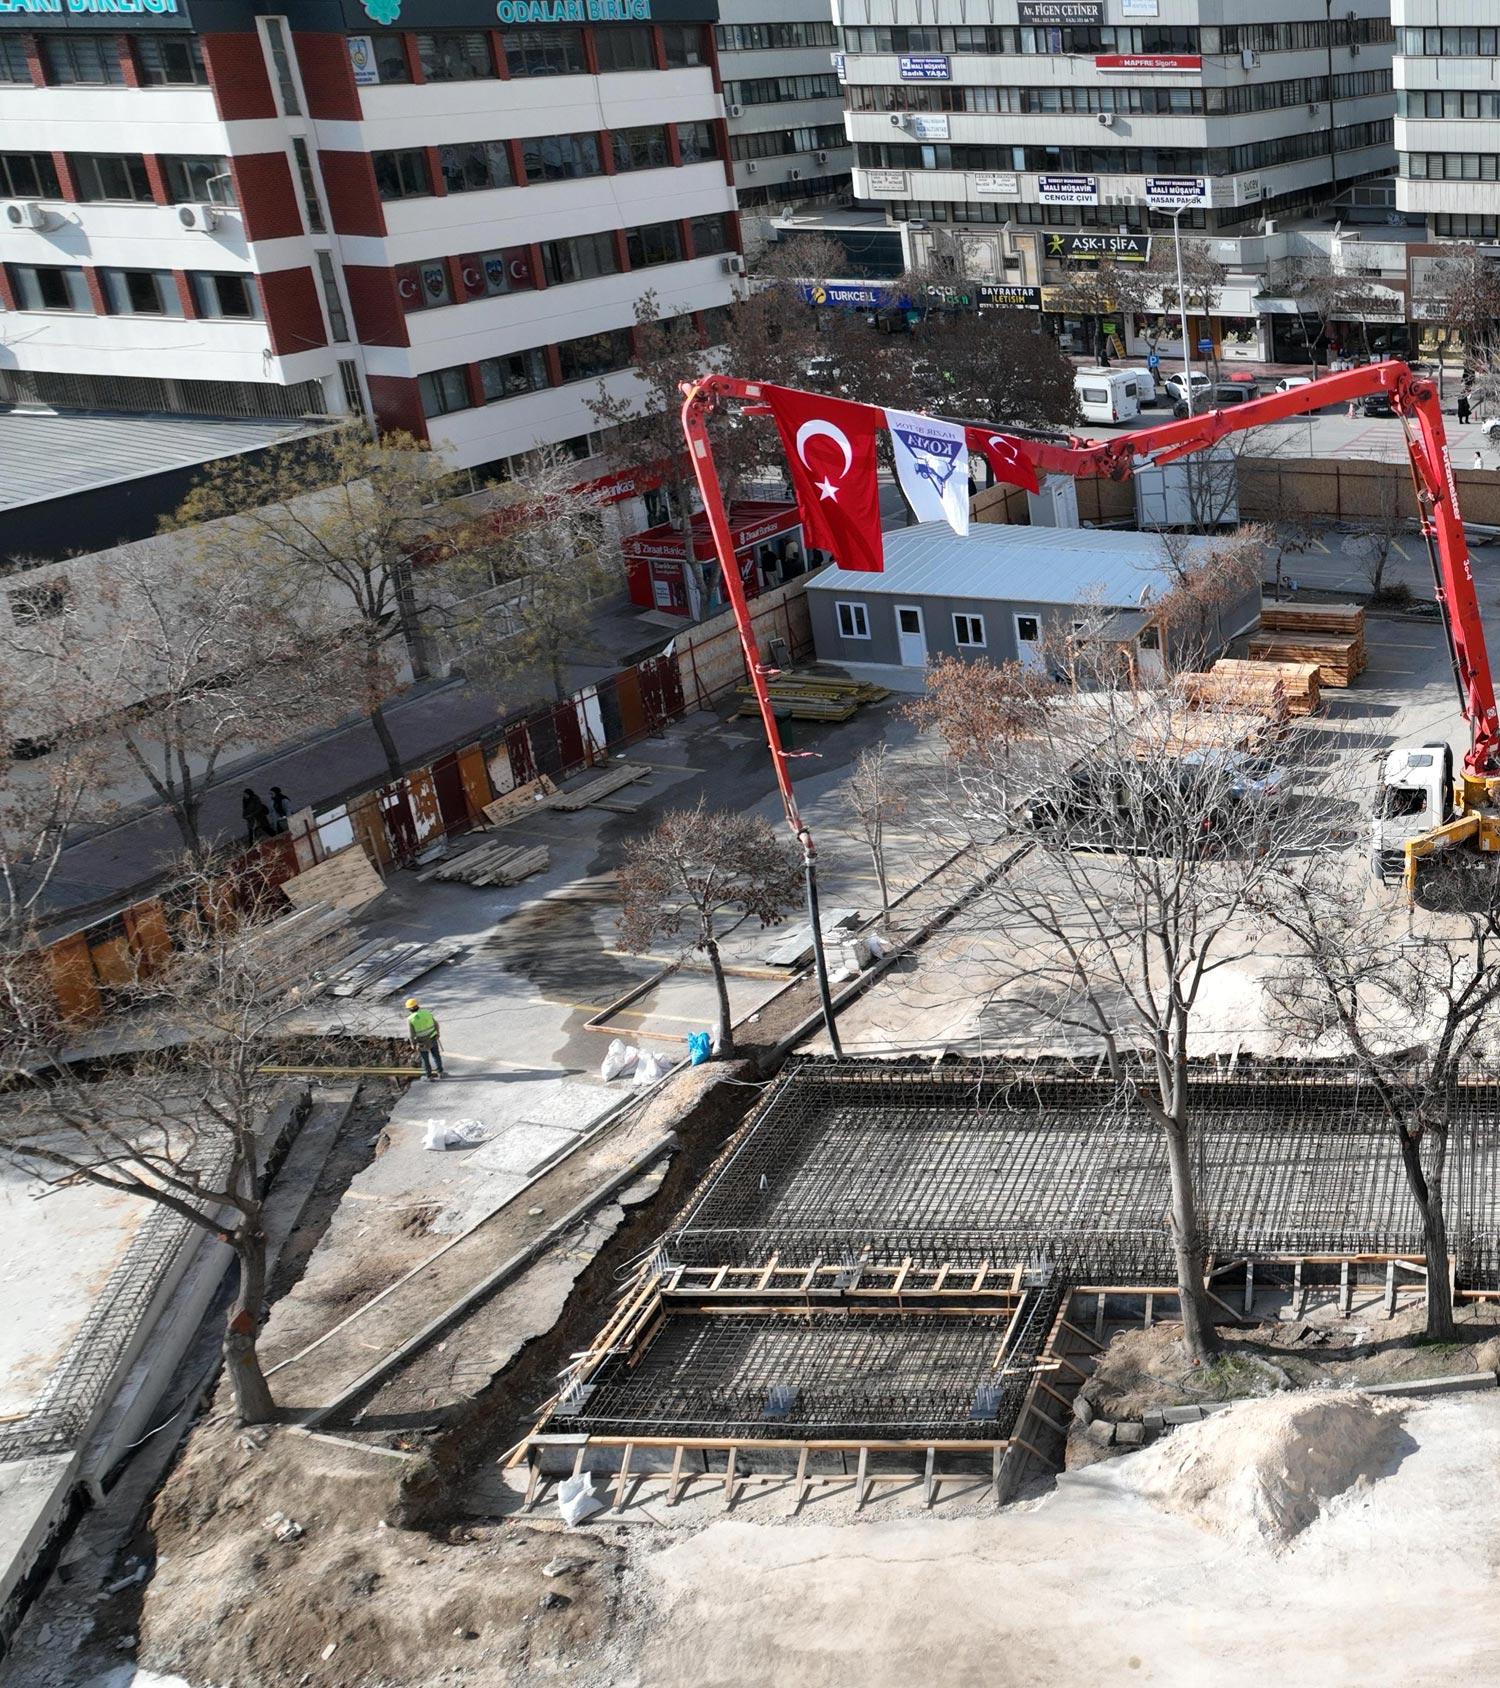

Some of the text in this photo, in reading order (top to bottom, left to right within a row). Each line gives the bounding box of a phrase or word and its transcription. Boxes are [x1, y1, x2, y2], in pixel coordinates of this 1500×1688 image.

[1023, 3, 1098, 17] Av. FİGEN ÇETİNER
[1124, 59, 1177, 68] MAPFRE Sigorta
[1060, 184, 1092, 193] MÜŞAVİR
[1168, 186, 1200, 195] MÜŞAVİR
[1044, 193, 1074, 201] CENGİZ
[1150, 196, 1175, 204] HASAN
[1072, 237, 1138, 252] AŞK-I ŞİFA
[981, 287, 1034, 296] BAYRAKTAR
[663, 545, 687, 555] Banka
